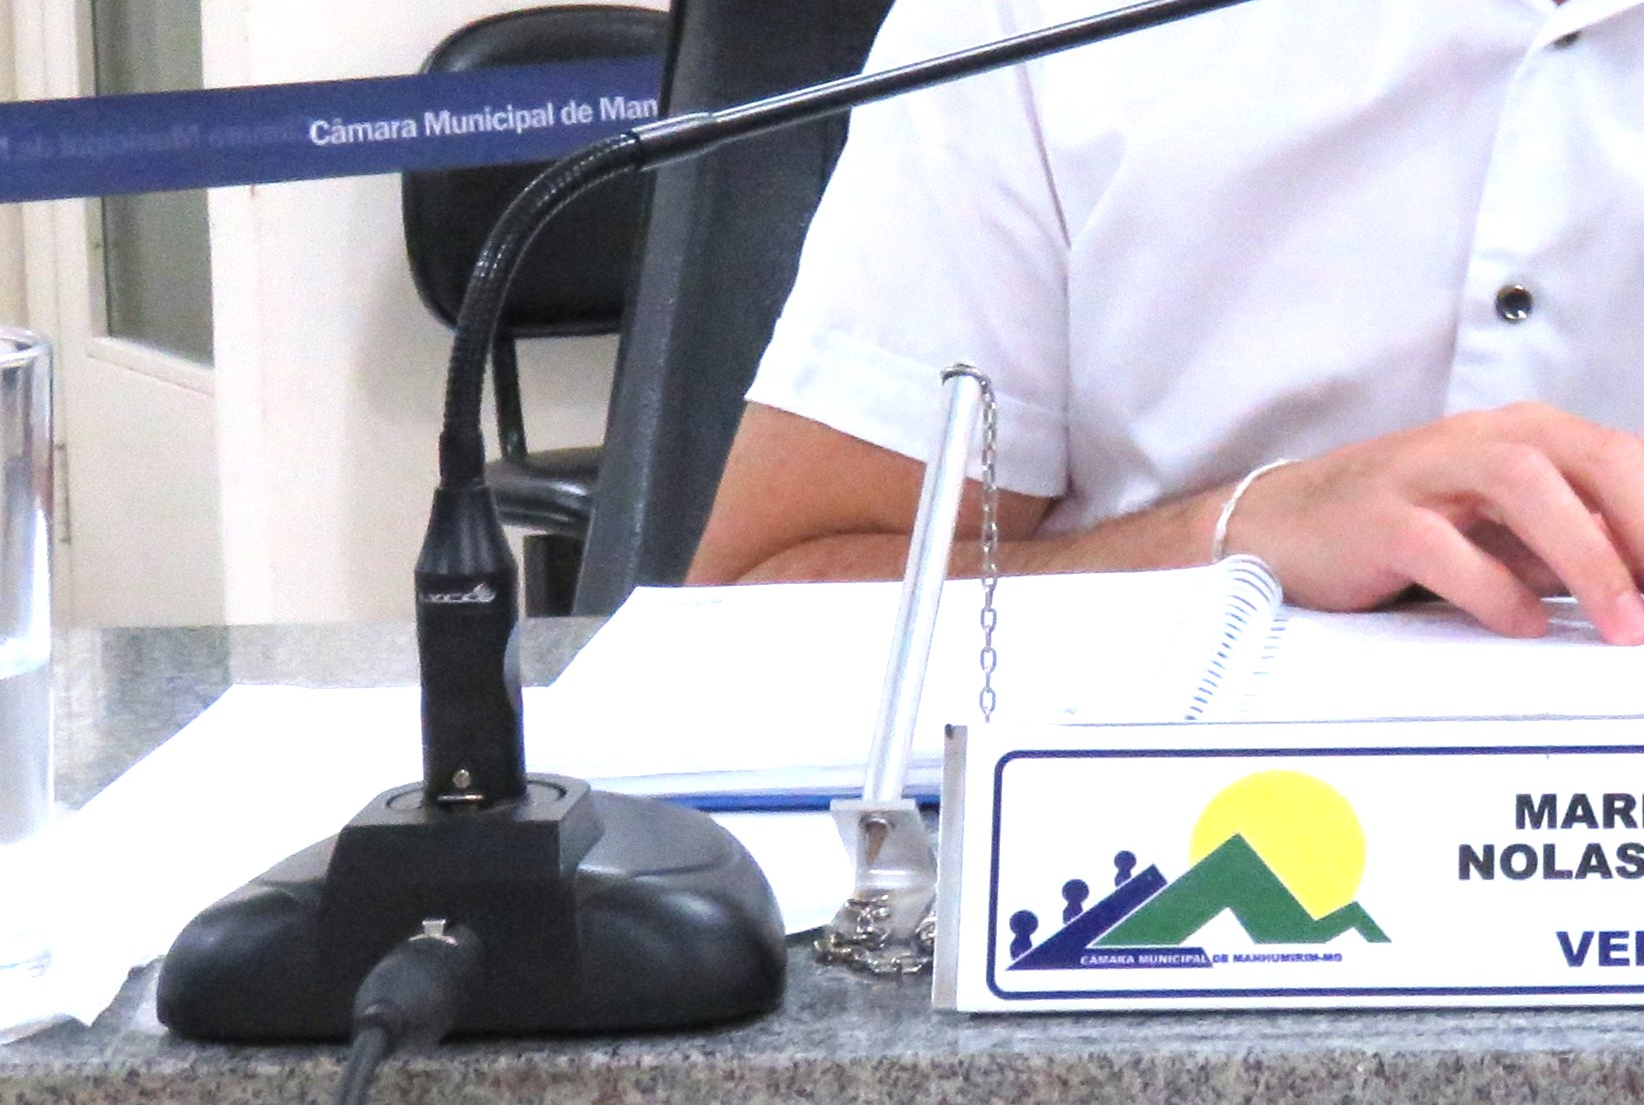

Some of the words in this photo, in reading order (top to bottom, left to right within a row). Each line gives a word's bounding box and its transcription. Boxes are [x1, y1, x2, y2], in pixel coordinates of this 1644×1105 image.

[309, 117, 418, 146] Câmara
[423, 102, 554, 137] Municipal
[560, 100, 594, 126] de
[600, 96, 659, 122] Man
[1138, 954, 1209, 965] MUNICIPAL
